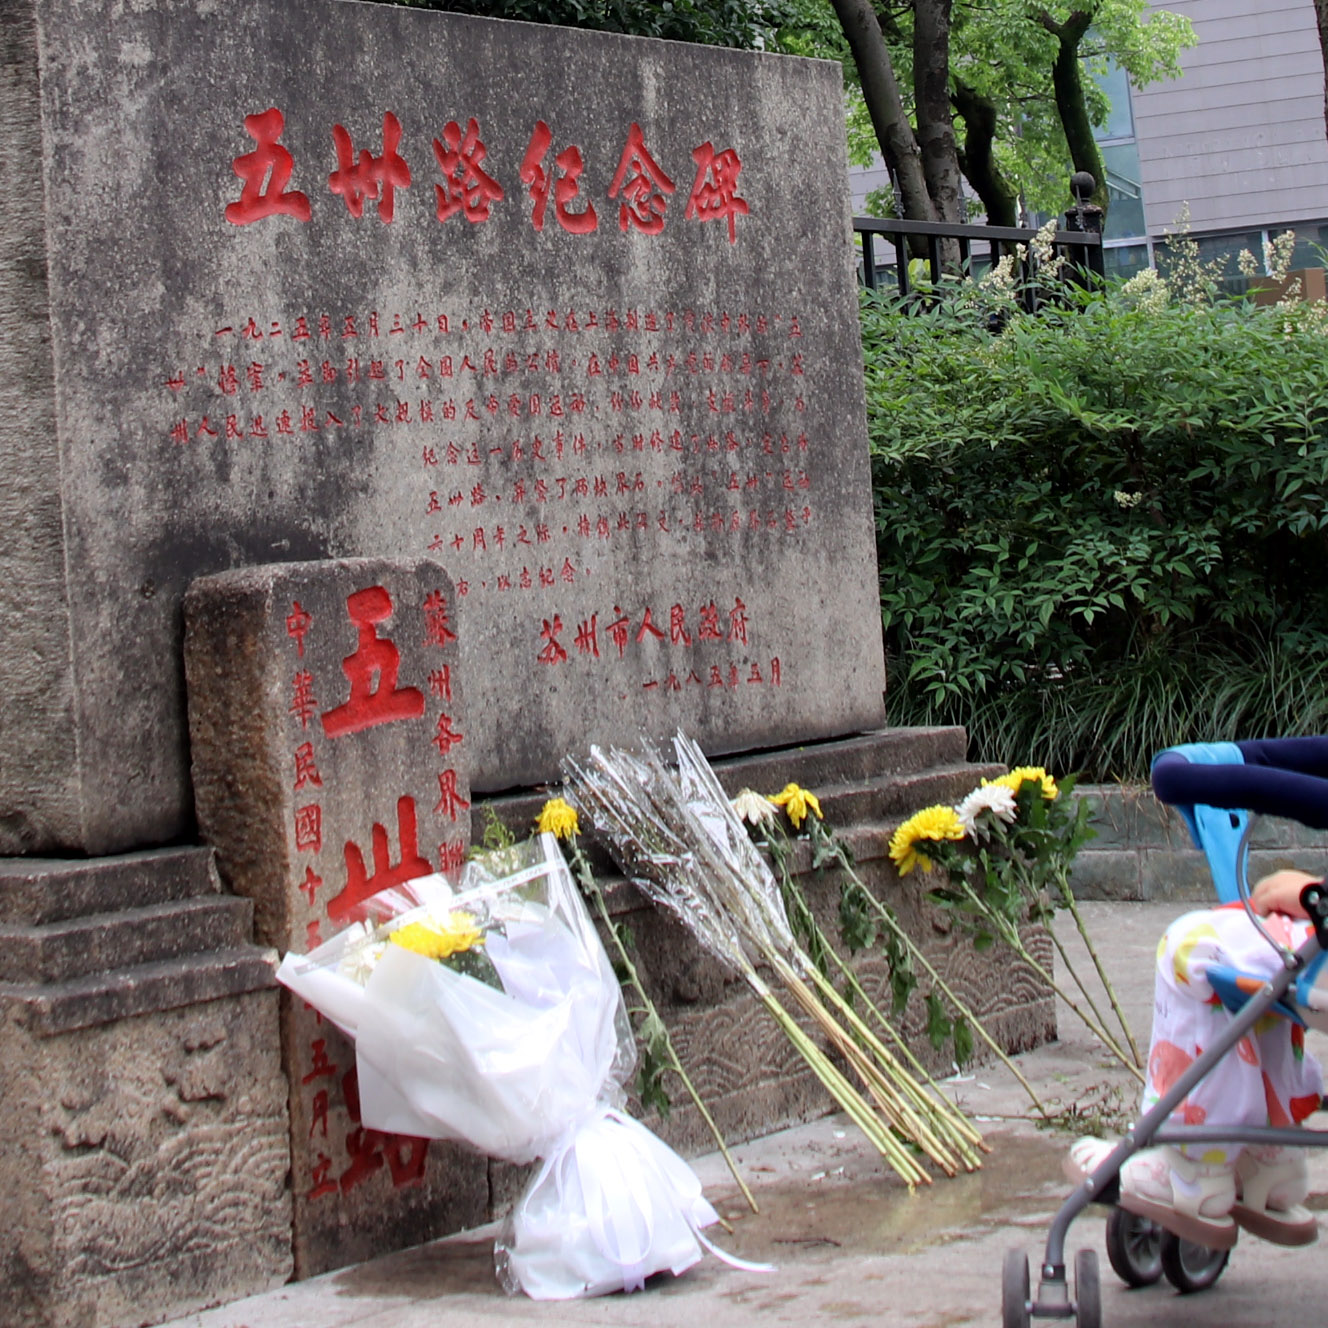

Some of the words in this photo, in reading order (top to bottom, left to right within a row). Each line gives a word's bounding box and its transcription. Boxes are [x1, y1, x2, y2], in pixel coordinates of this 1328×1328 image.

[225, 107, 749, 244] 五卅路纪念碑
[537, 596, 749, 666] 苏州市人民政府
[642, 656, 782, 692] 一九八五年五月
